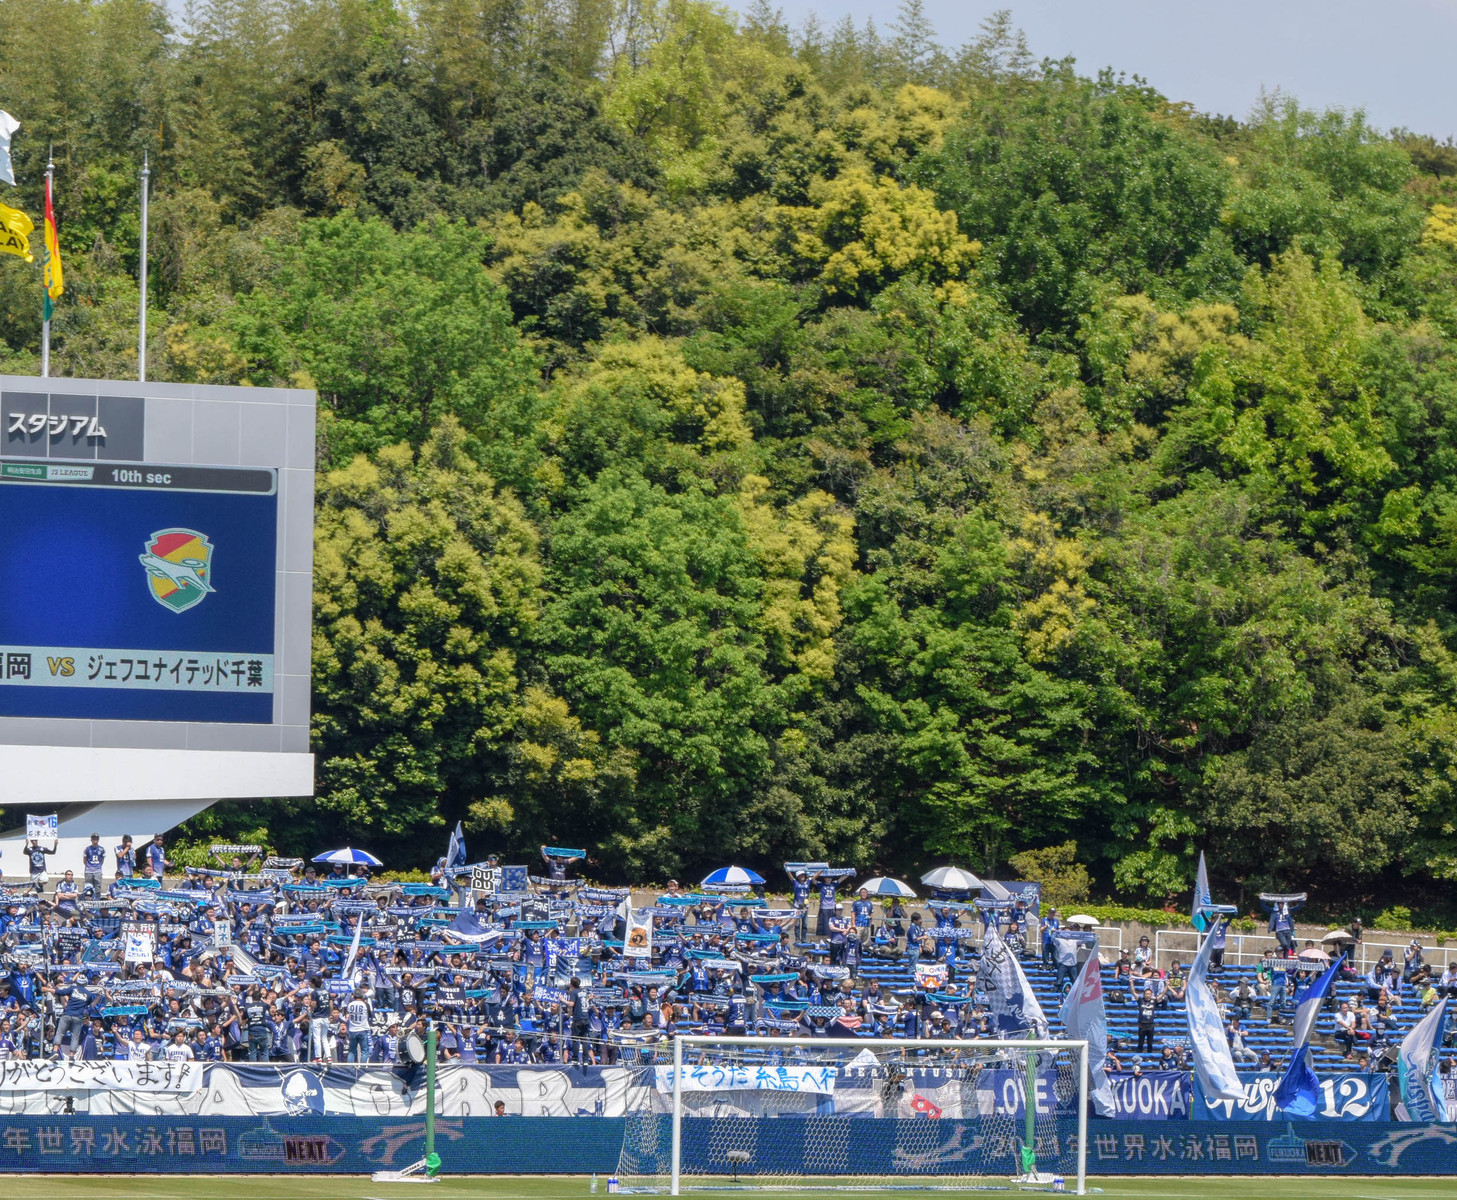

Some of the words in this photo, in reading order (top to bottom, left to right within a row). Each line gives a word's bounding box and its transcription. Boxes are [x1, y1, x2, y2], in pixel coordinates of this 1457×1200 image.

[8, 411, 107, 438] スタジアム
[112, 469, 142, 483] 10th
[146, 472, 172, 484] sec
[47, 656, 75, 677] VS
[87, 655, 263, 688] ジェフユナイテッド千葉
[475, 870, 491, 880] DU
[475, 879, 491, 889] DU
[907, 1067, 963, 1078] KYUSH
[997, 1078, 1049, 1115] OVE
[1112, 1077, 1186, 1115] KUOKA
[1320, 1077, 1370, 1118] 12
[286, 1141, 327, 1160] NEXT
[1307, 1144, 1343, 1162] NEXT
